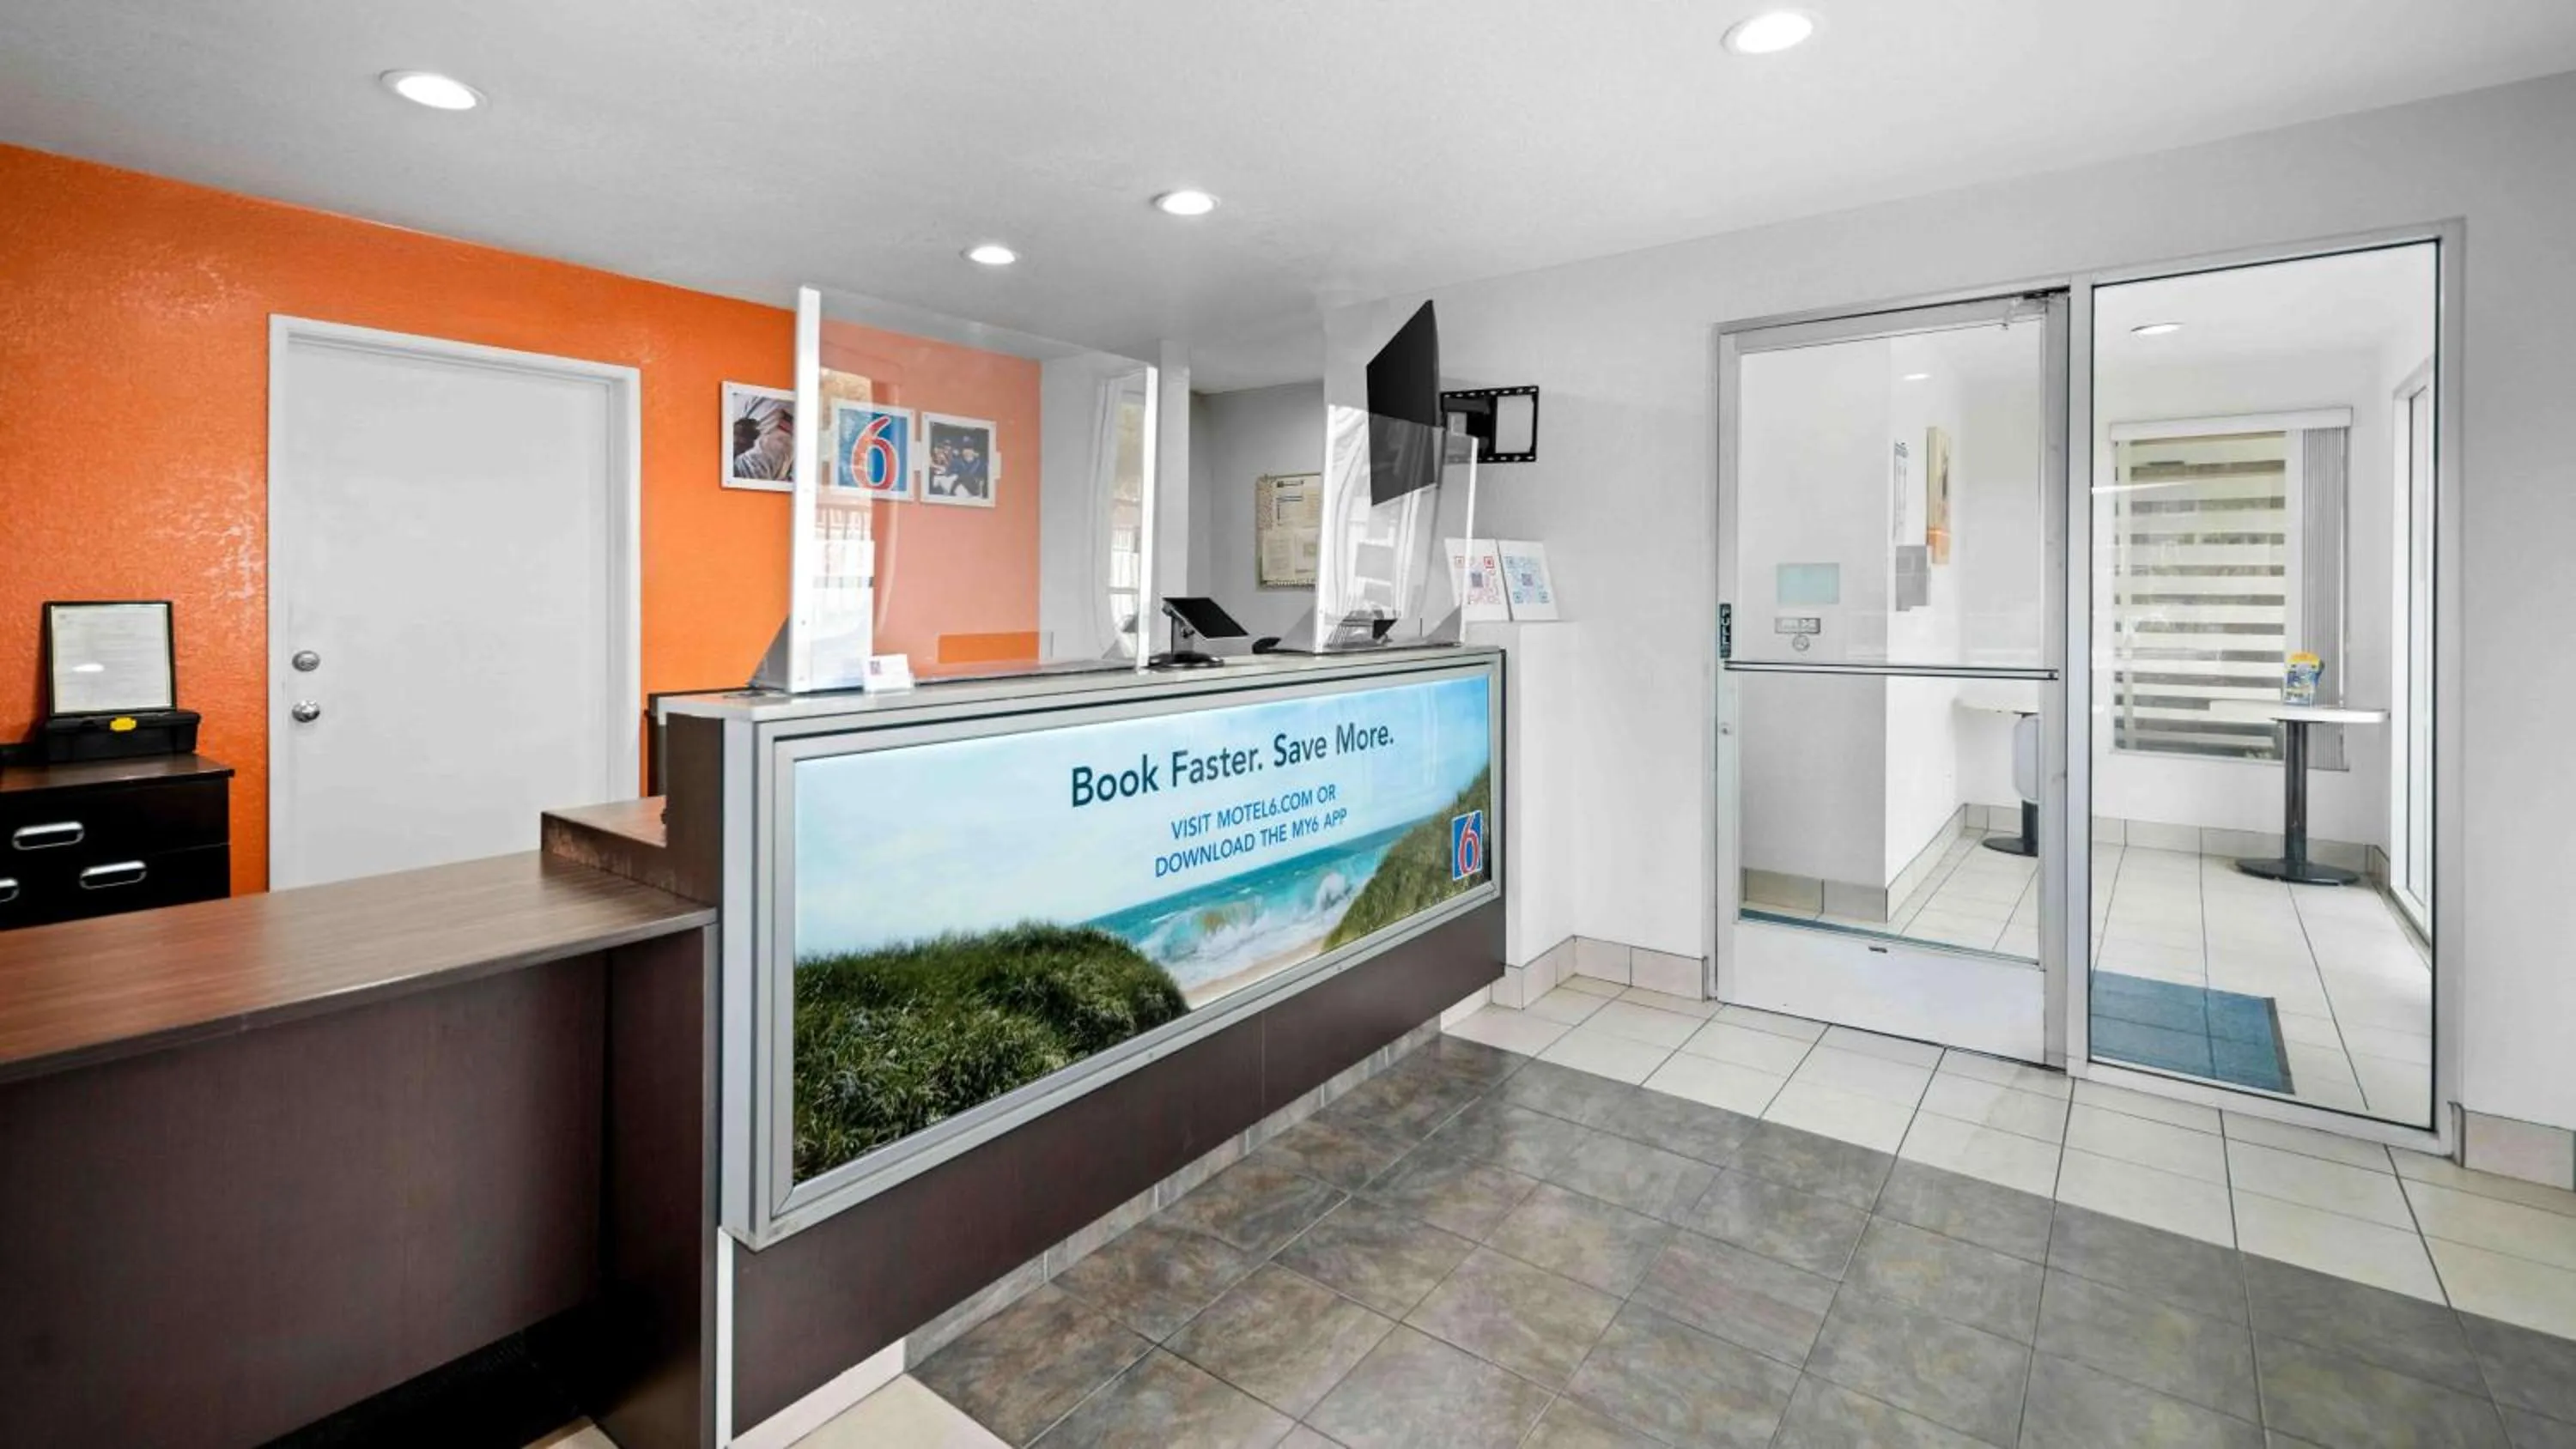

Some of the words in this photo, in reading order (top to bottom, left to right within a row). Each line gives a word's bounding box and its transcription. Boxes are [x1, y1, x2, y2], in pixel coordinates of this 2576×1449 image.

[851, 415, 899, 491] 6
[1072, 754, 1159, 808] Book
[1172, 747, 1263, 788] Faster.
[1273, 732, 1327, 767] Save
[1336, 722, 1394, 755] More.
[1155, 834, 1255, 877] DOWNLOAD
[1260, 823, 1287, 847] THE
[1292, 815, 1320, 839] MY6
[1323, 808, 1347, 830] APP
[1170, 813, 1212, 840] VISIT
[1217, 790, 1314, 829] MOTEL6.COM
[1316, 784, 1337, 803] OR
[1458, 813, 1479, 876] 6
